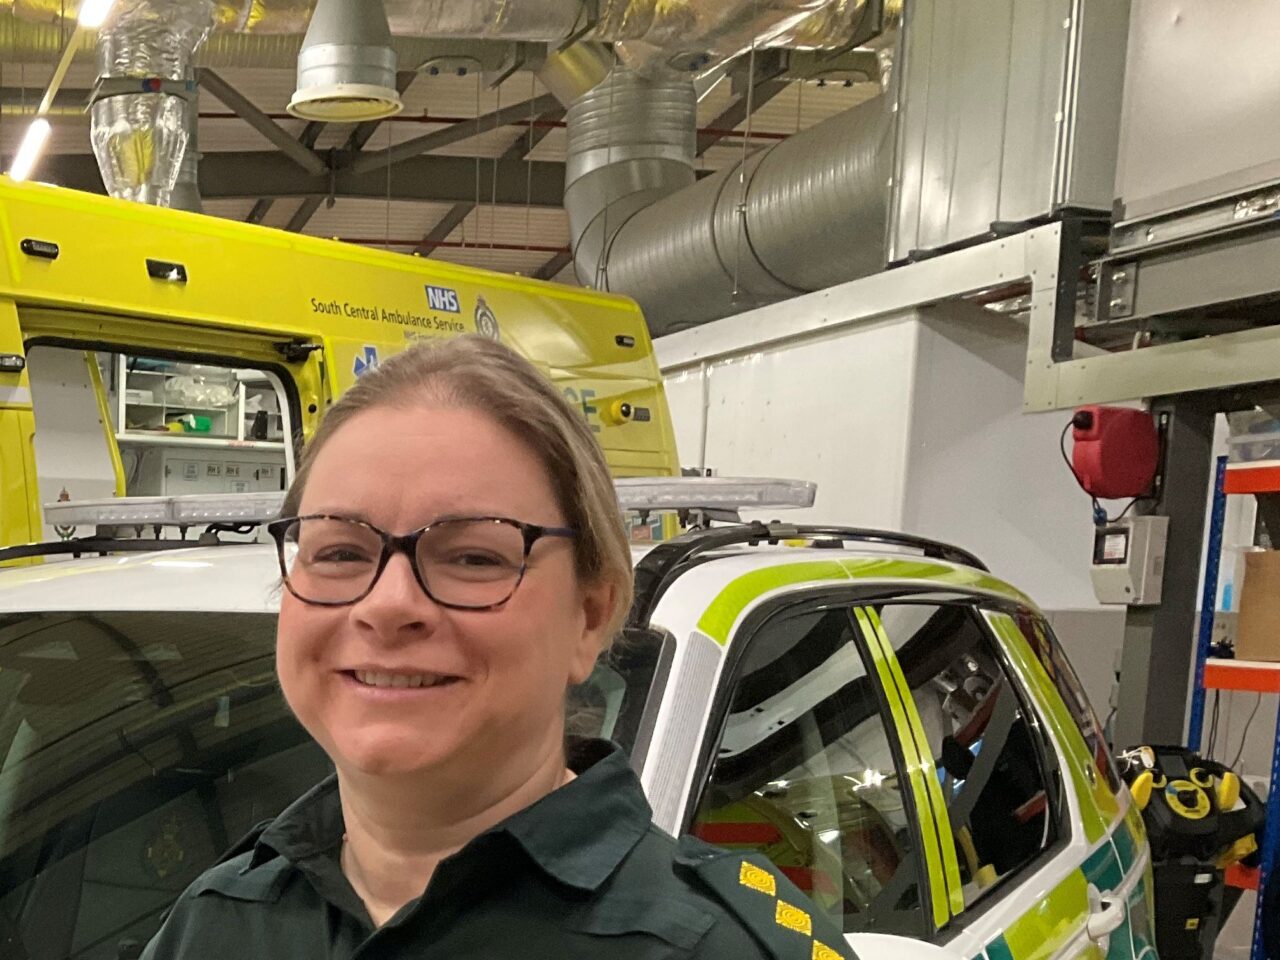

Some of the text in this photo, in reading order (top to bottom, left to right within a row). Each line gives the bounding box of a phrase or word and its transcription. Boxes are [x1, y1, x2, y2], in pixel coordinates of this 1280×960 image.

[427, 287, 458, 311] NHS
[311, 297, 464, 332] South Central Ambulance Service
